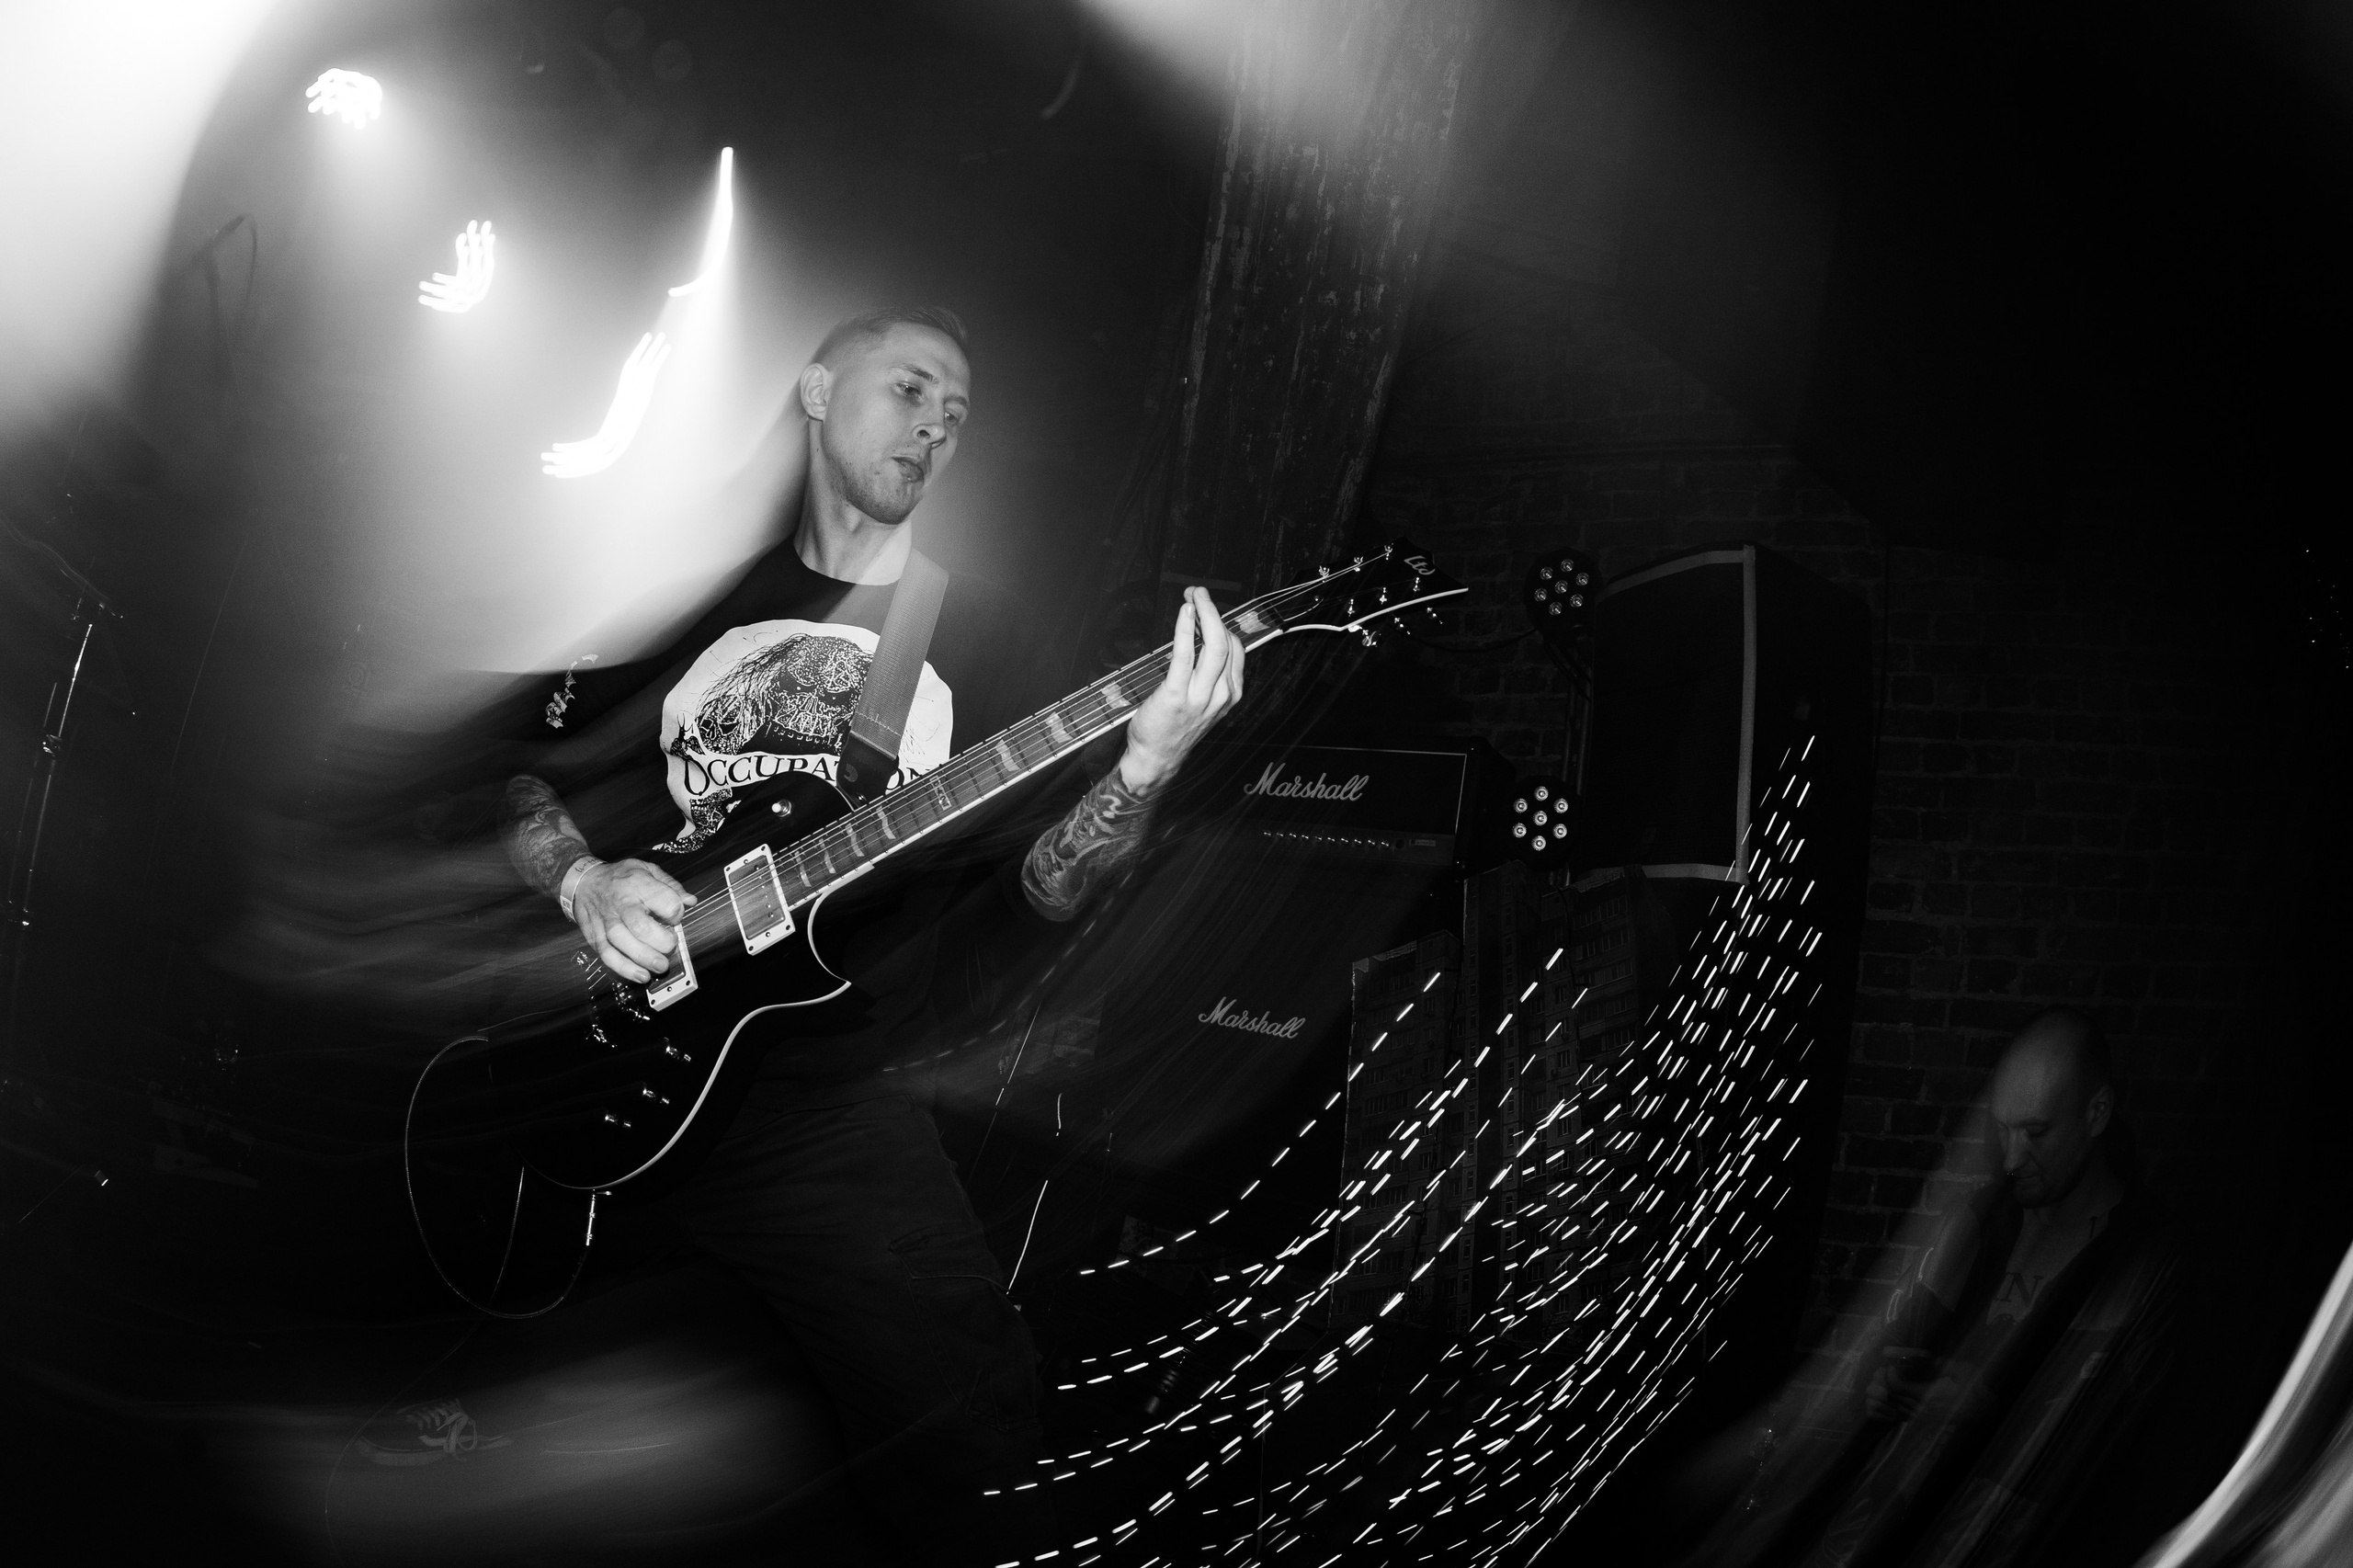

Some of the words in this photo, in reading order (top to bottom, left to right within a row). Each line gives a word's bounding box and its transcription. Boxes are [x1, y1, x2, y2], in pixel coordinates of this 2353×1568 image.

[684, 755, 930, 797] OCCUPAO
[1243, 761, 1370, 801] Marshall
[1198, 996, 1306, 1040] Marshall
